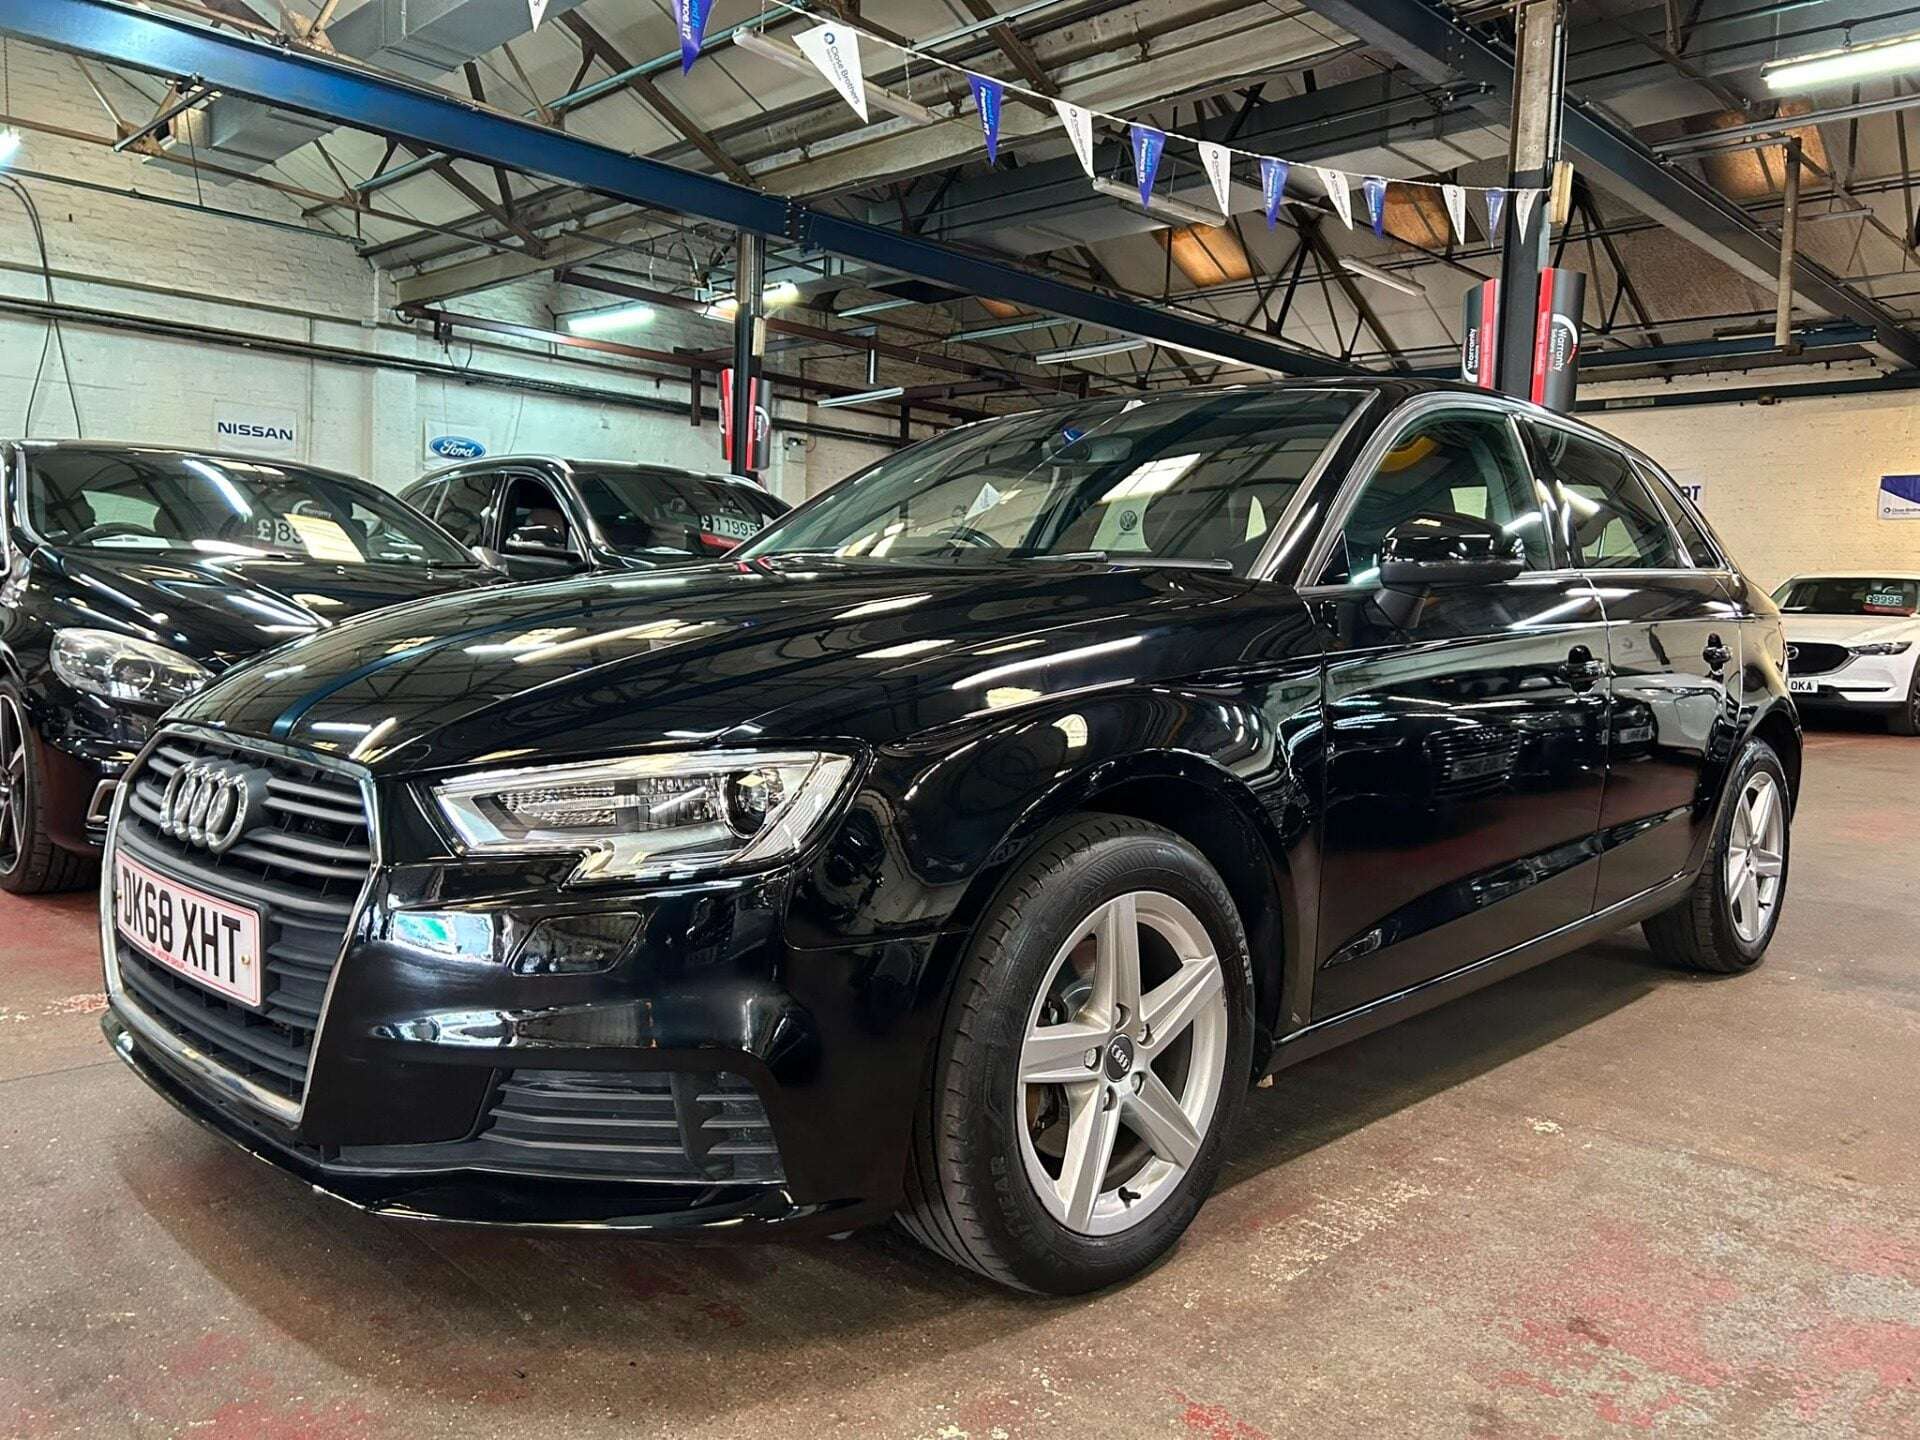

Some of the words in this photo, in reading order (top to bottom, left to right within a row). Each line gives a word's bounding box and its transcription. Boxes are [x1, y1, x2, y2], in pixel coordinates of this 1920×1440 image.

[682, 23, 692, 40] it?
[831, 46, 845, 69] Close
[840, 69, 860, 105] Brothers
[1467, 328, 1478, 370] Warranty
[1554, 327, 1568, 372] Warranty
[218, 422, 293, 440] NISSAN
[440, 440, 476, 457] Ford
[122, 865, 174, 953] DK68
[181, 898, 241, 984] XHT
